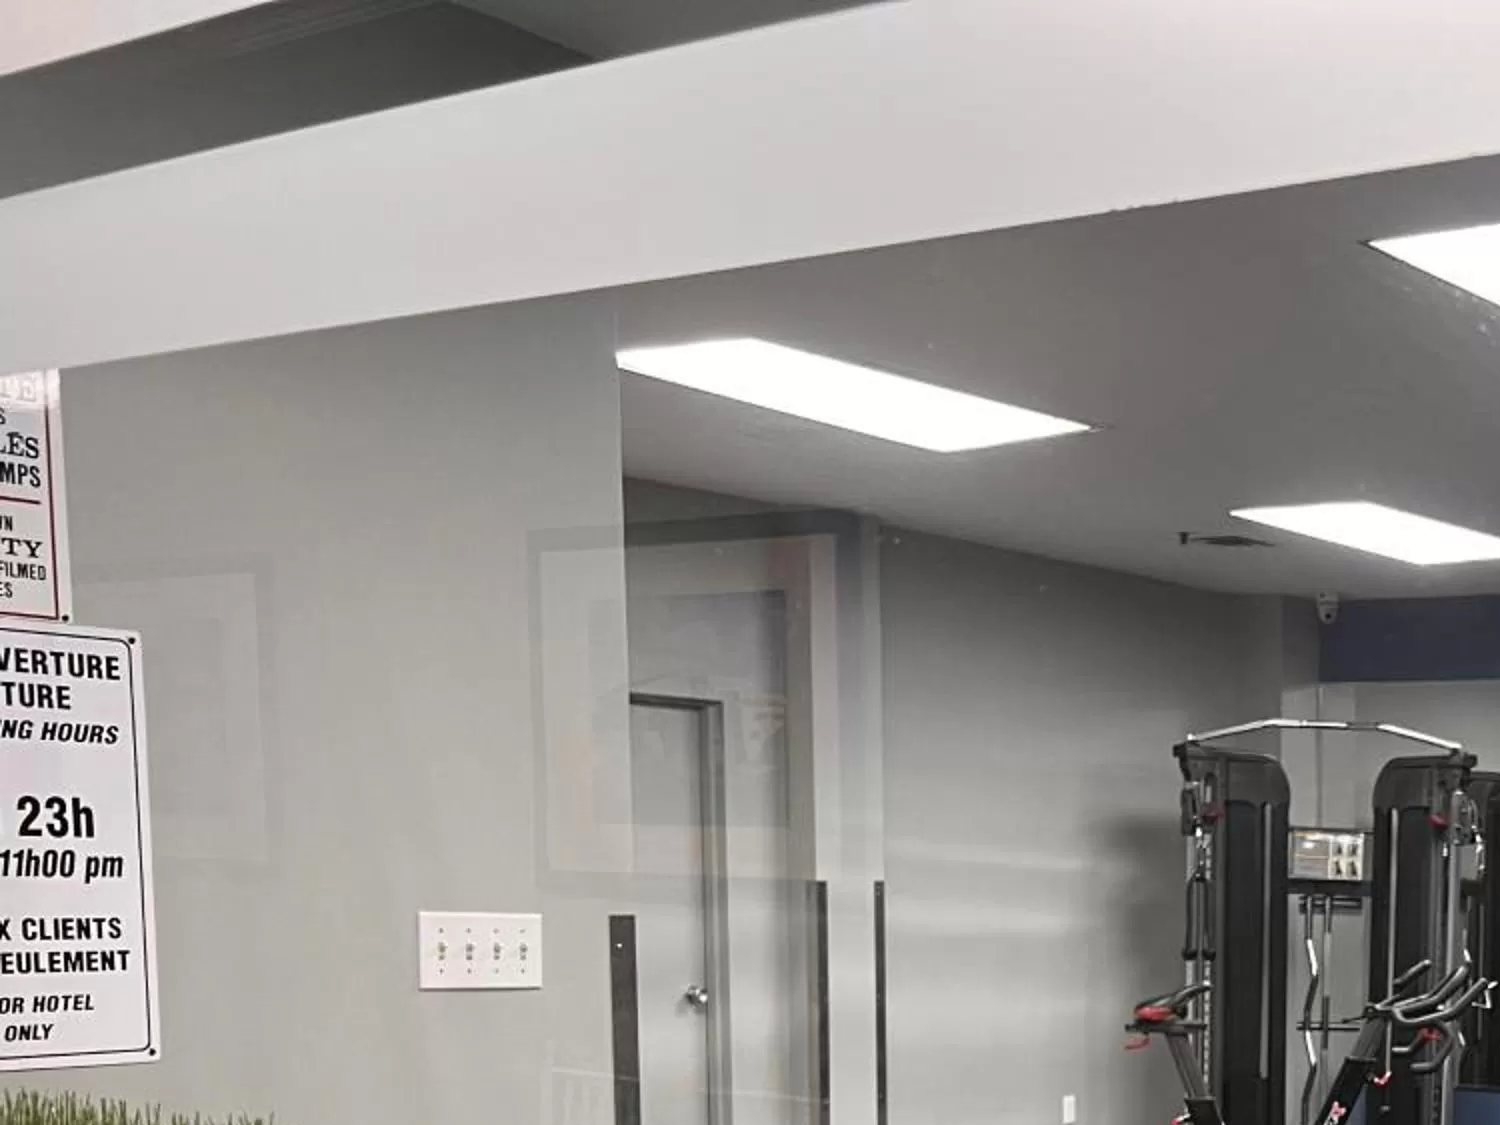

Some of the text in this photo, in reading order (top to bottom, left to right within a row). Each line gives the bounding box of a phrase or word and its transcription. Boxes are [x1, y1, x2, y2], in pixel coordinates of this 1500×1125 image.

[0, 682, 71, 709] TURE
[0, 719, 119, 745] NG HOURS
[17, 795, 95, 838] 23h
[0, 849, 123, 884] 11h00 pm
[22, 917, 122, 941] CLIENTS
[0, 949, 130, 975] EULEMENT
[32, 994, 95, 1013] HOTEL
[5, 1024, 54, 1042] ONLY
